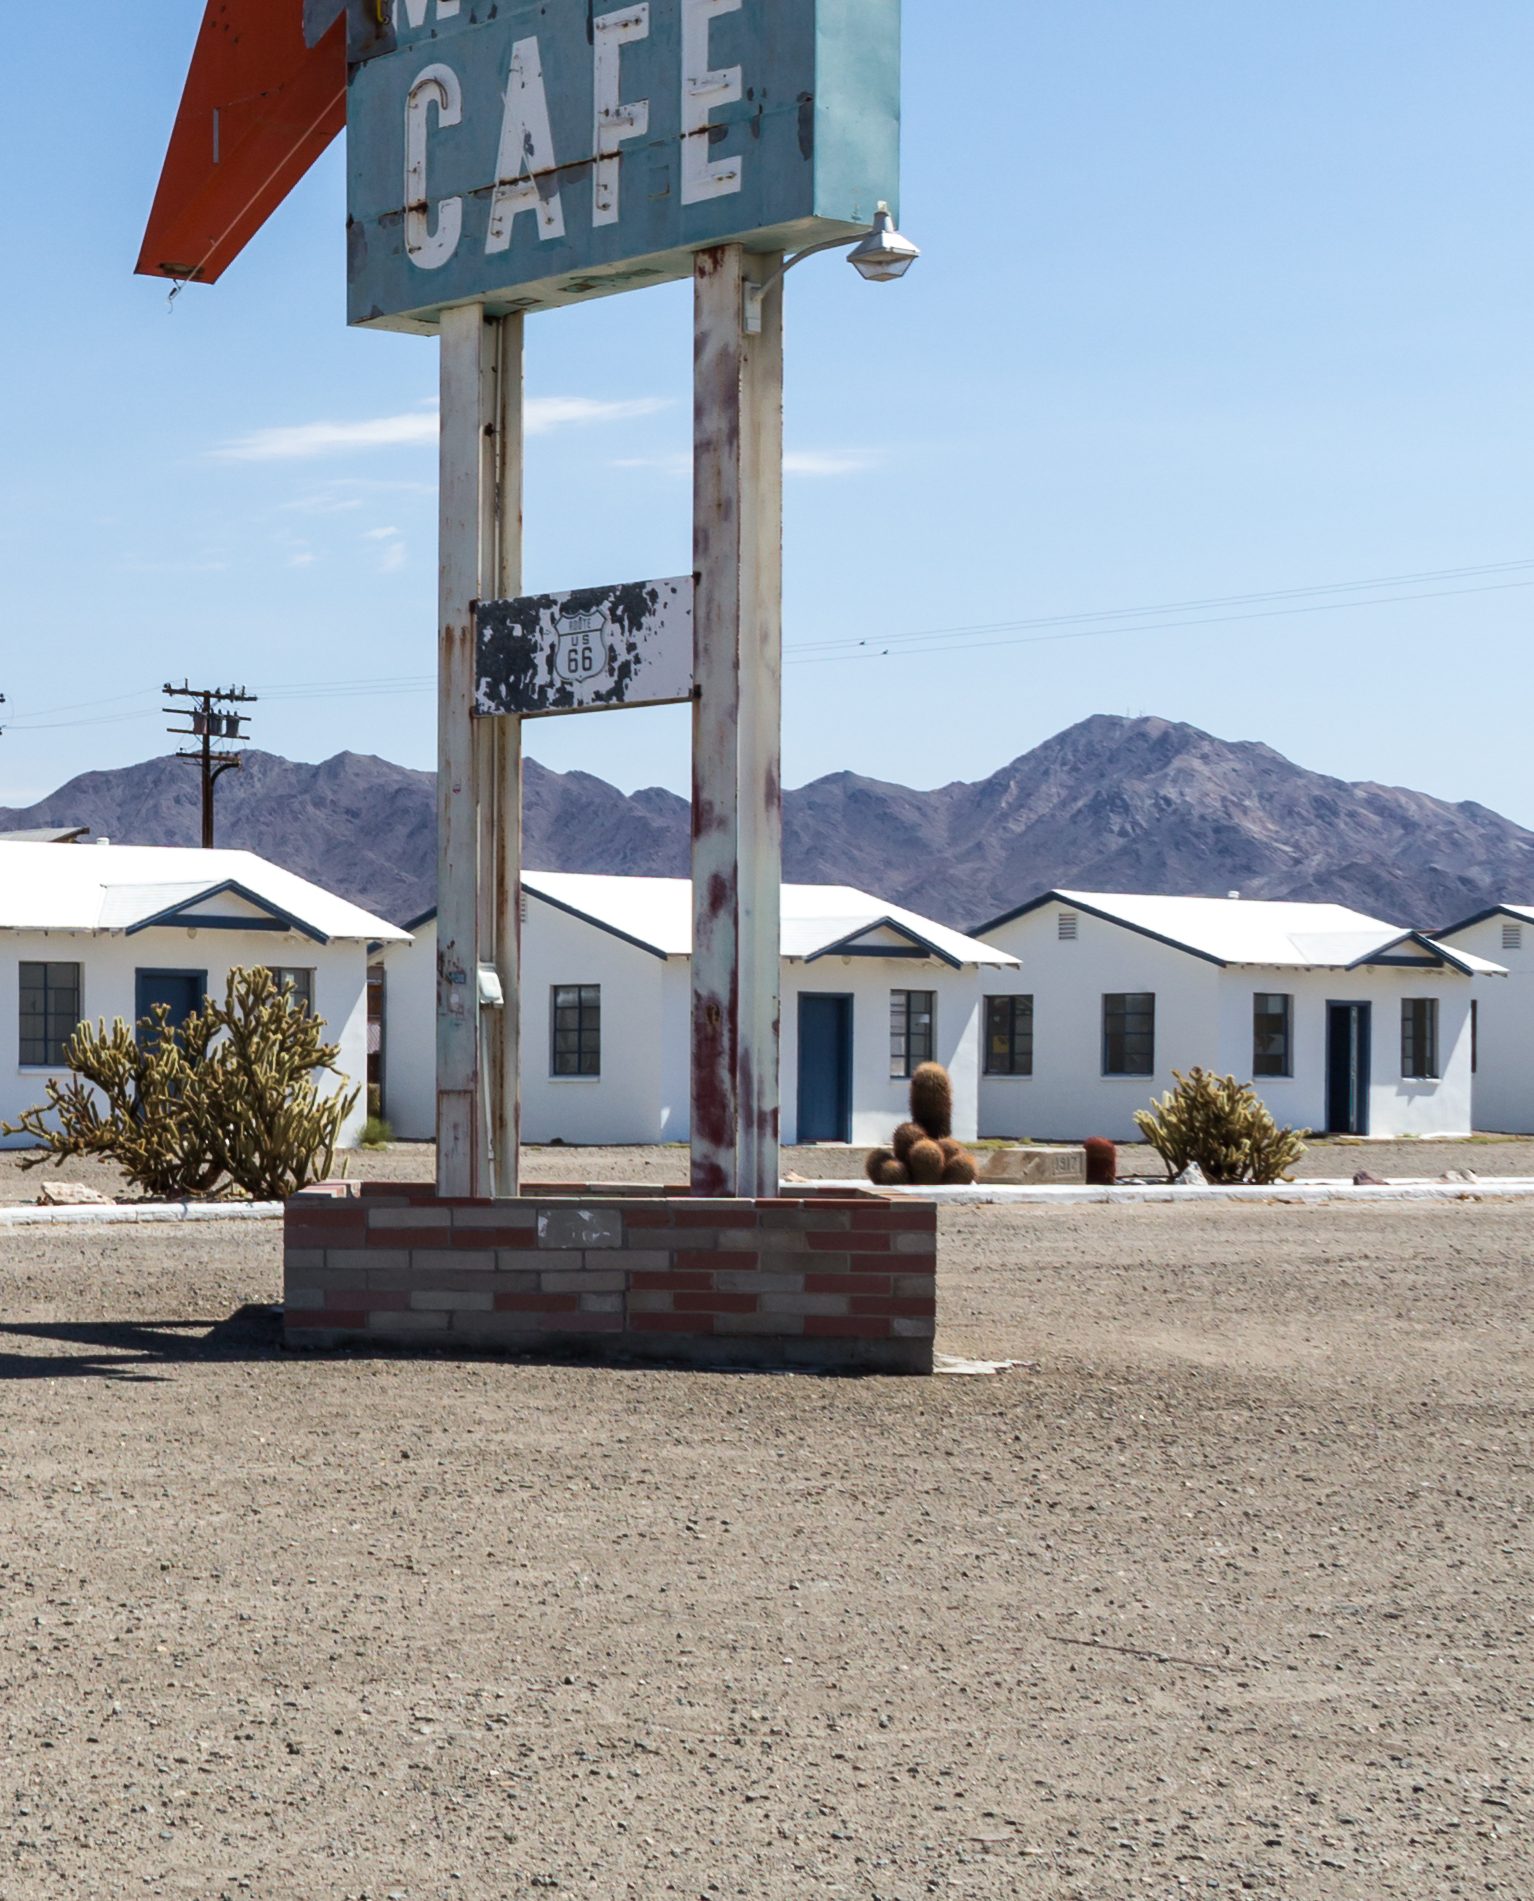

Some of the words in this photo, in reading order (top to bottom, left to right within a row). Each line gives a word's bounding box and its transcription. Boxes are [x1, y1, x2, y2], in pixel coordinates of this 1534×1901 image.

[569, 616, 591, 631] ROUTE
[571, 634, 589, 646] US
[568, 646, 592, 673] 66
